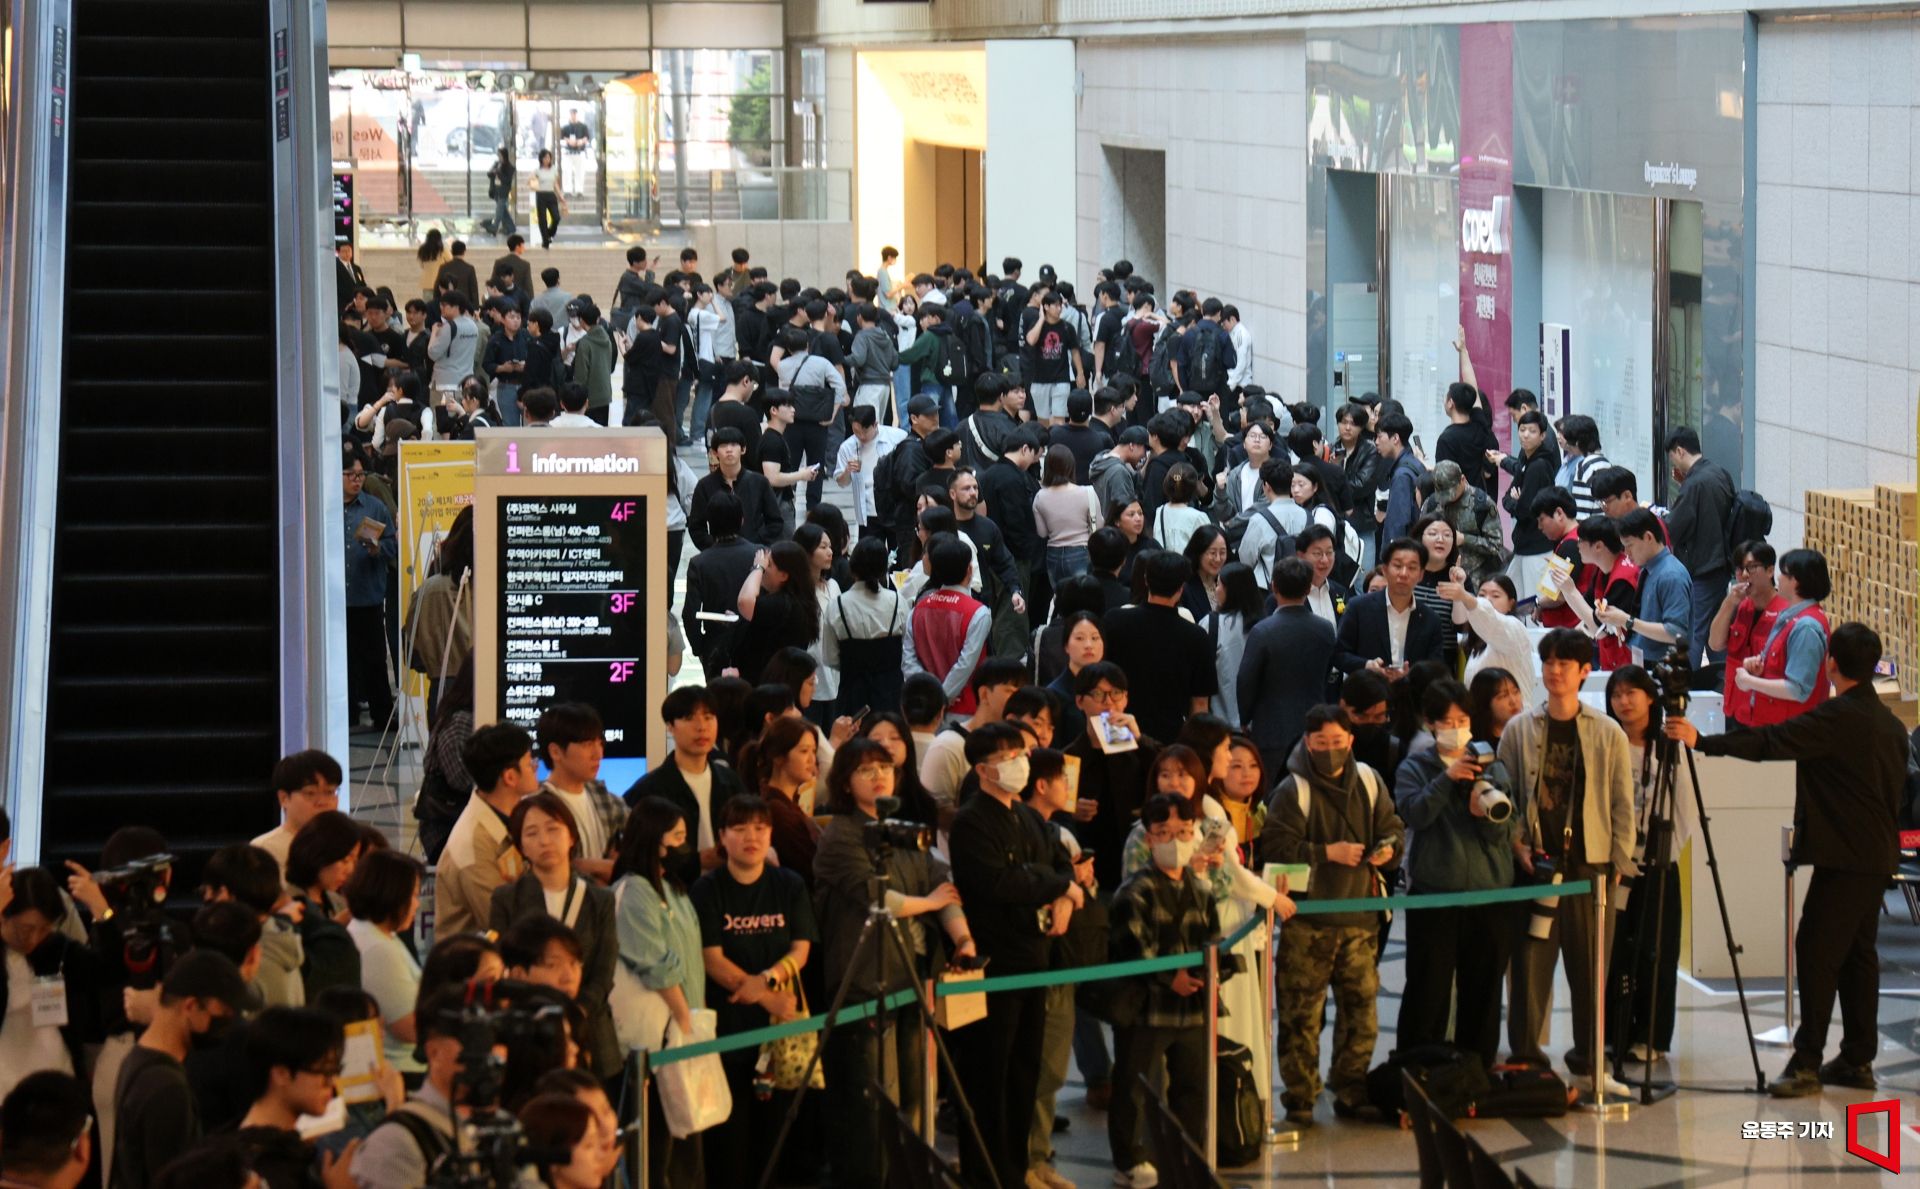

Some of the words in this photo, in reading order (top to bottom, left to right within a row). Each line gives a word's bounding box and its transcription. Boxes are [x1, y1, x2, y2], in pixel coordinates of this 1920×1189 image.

[610, 502, 637, 521] 4F
[534, 594, 543, 605] C
[610, 593, 636, 613] 3F
[610, 662, 635, 682] 2F
